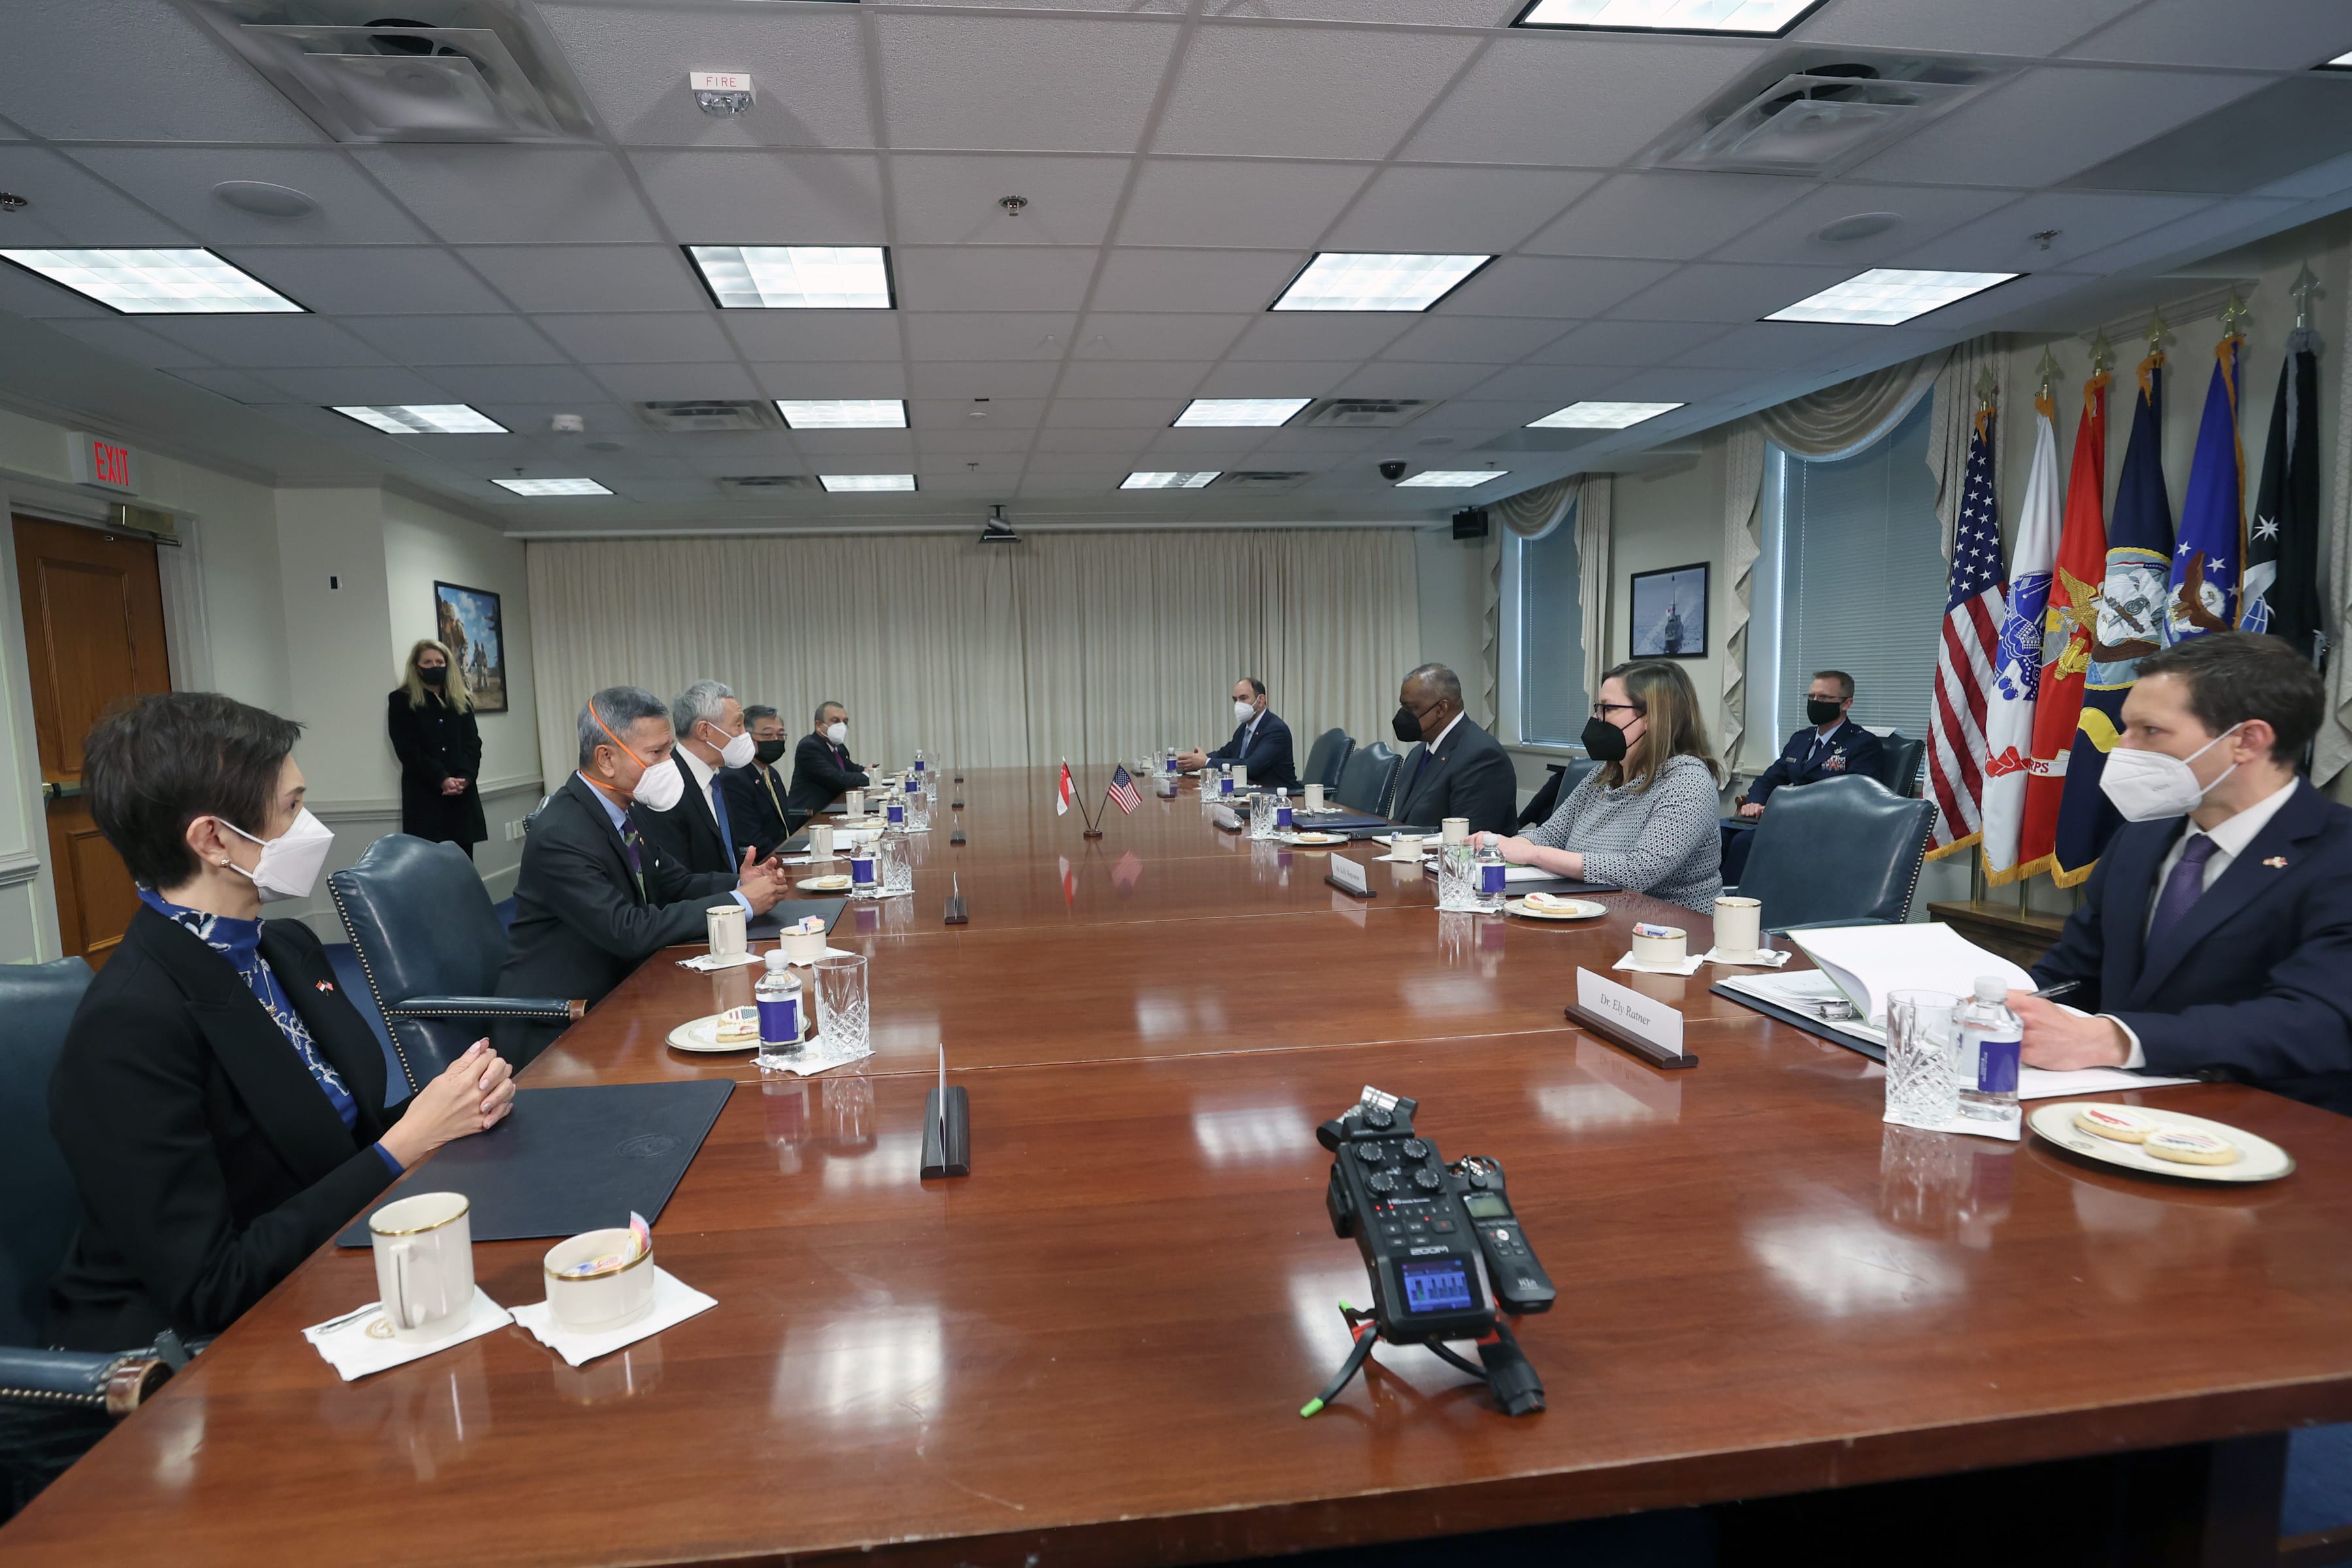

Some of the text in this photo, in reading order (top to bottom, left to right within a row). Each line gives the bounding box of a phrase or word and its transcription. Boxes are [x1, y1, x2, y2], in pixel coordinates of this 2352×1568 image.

[706, 76, 737, 88] FIRE
[93, 441, 129, 487] EXIT
[1600, 993, 1651, 1026] Dr. Ely Ratner
[1409, 1245, 1450, 1256] ZOOM
